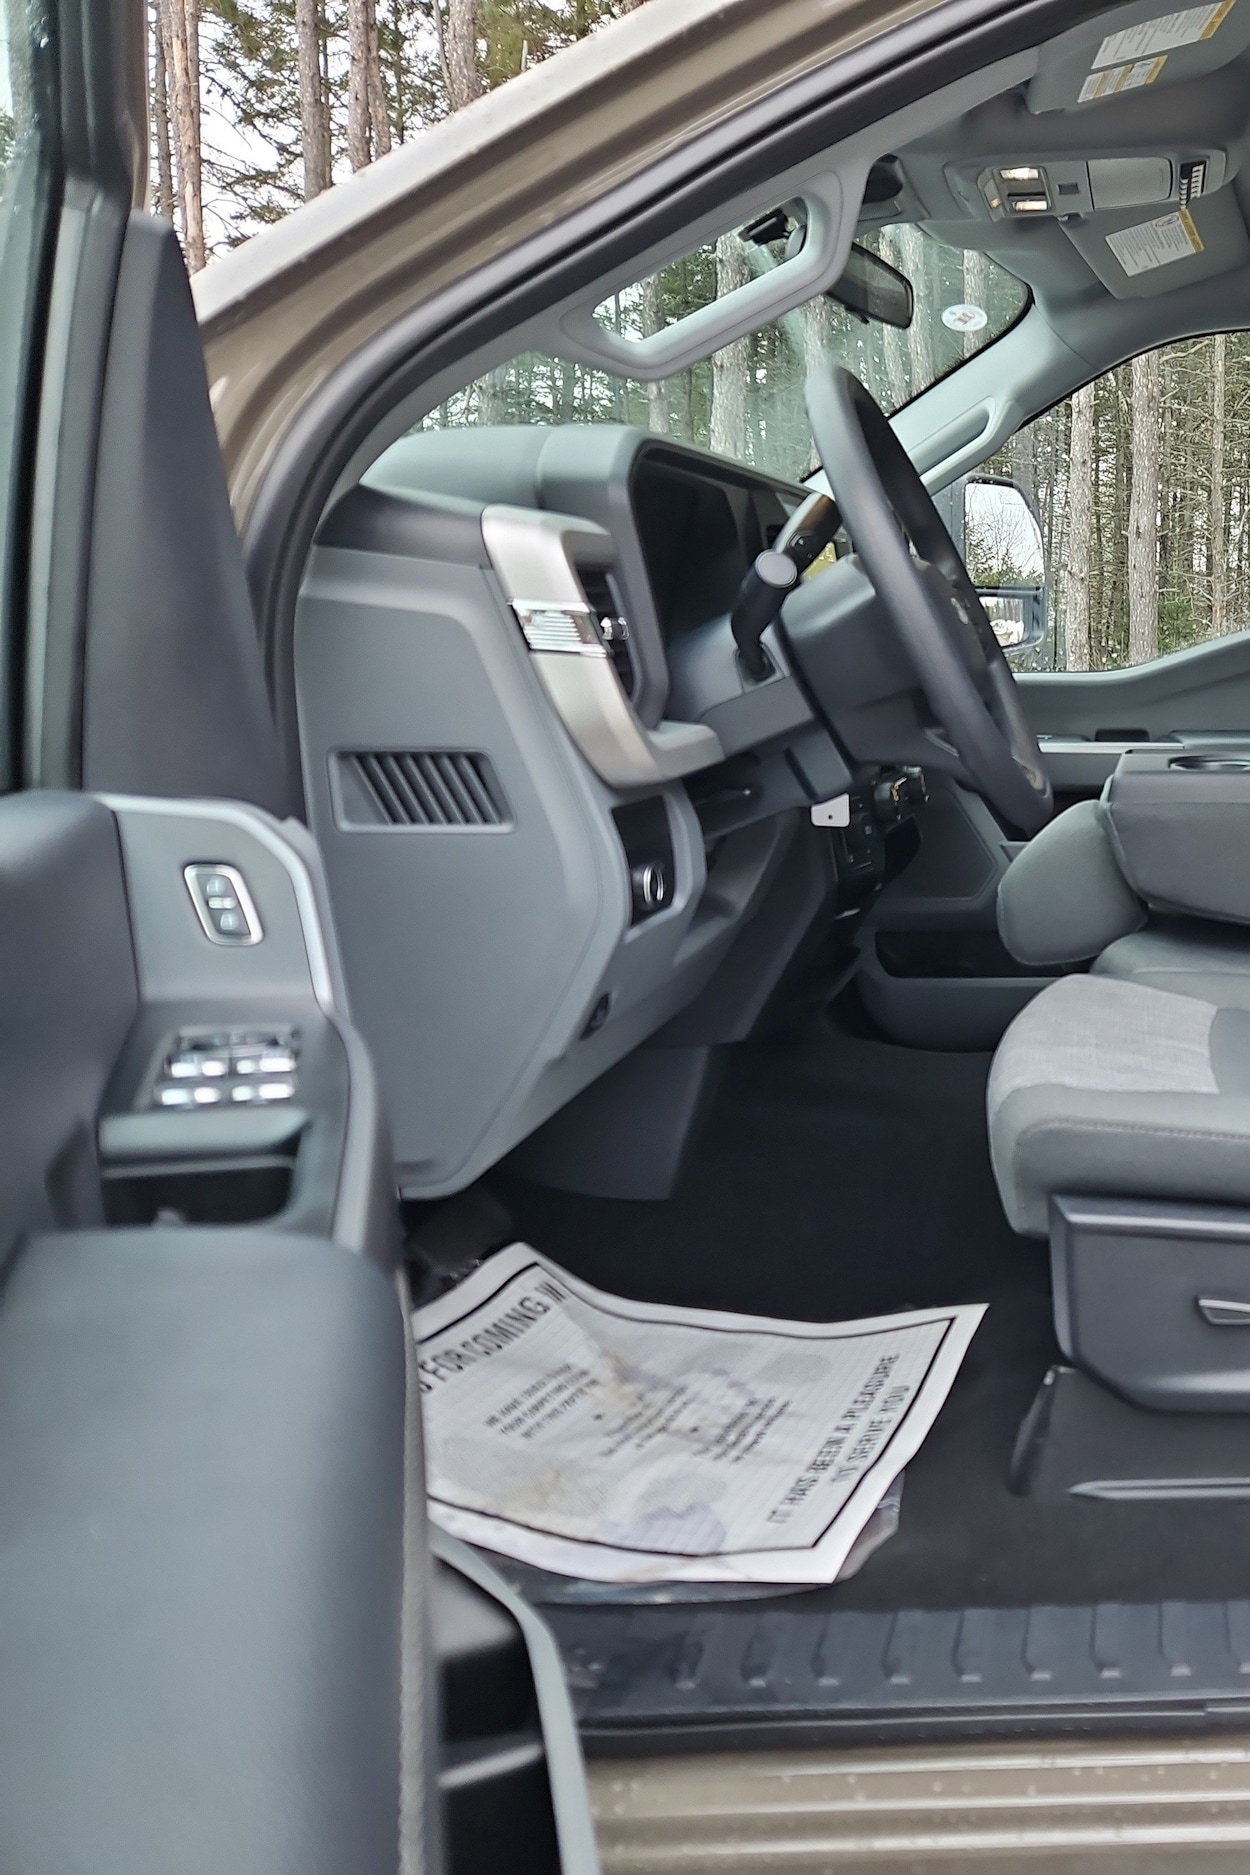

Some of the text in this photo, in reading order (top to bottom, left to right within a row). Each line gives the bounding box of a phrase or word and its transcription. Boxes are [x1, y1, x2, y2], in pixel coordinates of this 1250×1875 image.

[419, 1348, 478, 1382] FOR
[460, 1296, 550, 1356] COMING
[841, 1354, 900, 1421] PLEASURE
[833, 1423, 856, 1435] A
[846, 1419, 893, 1463] SERVE
[880, 1385, 911, 1414] YOU
[806, 1436, 847, 1475] BEEN
[780, 1475, 820, 1506] HAS
